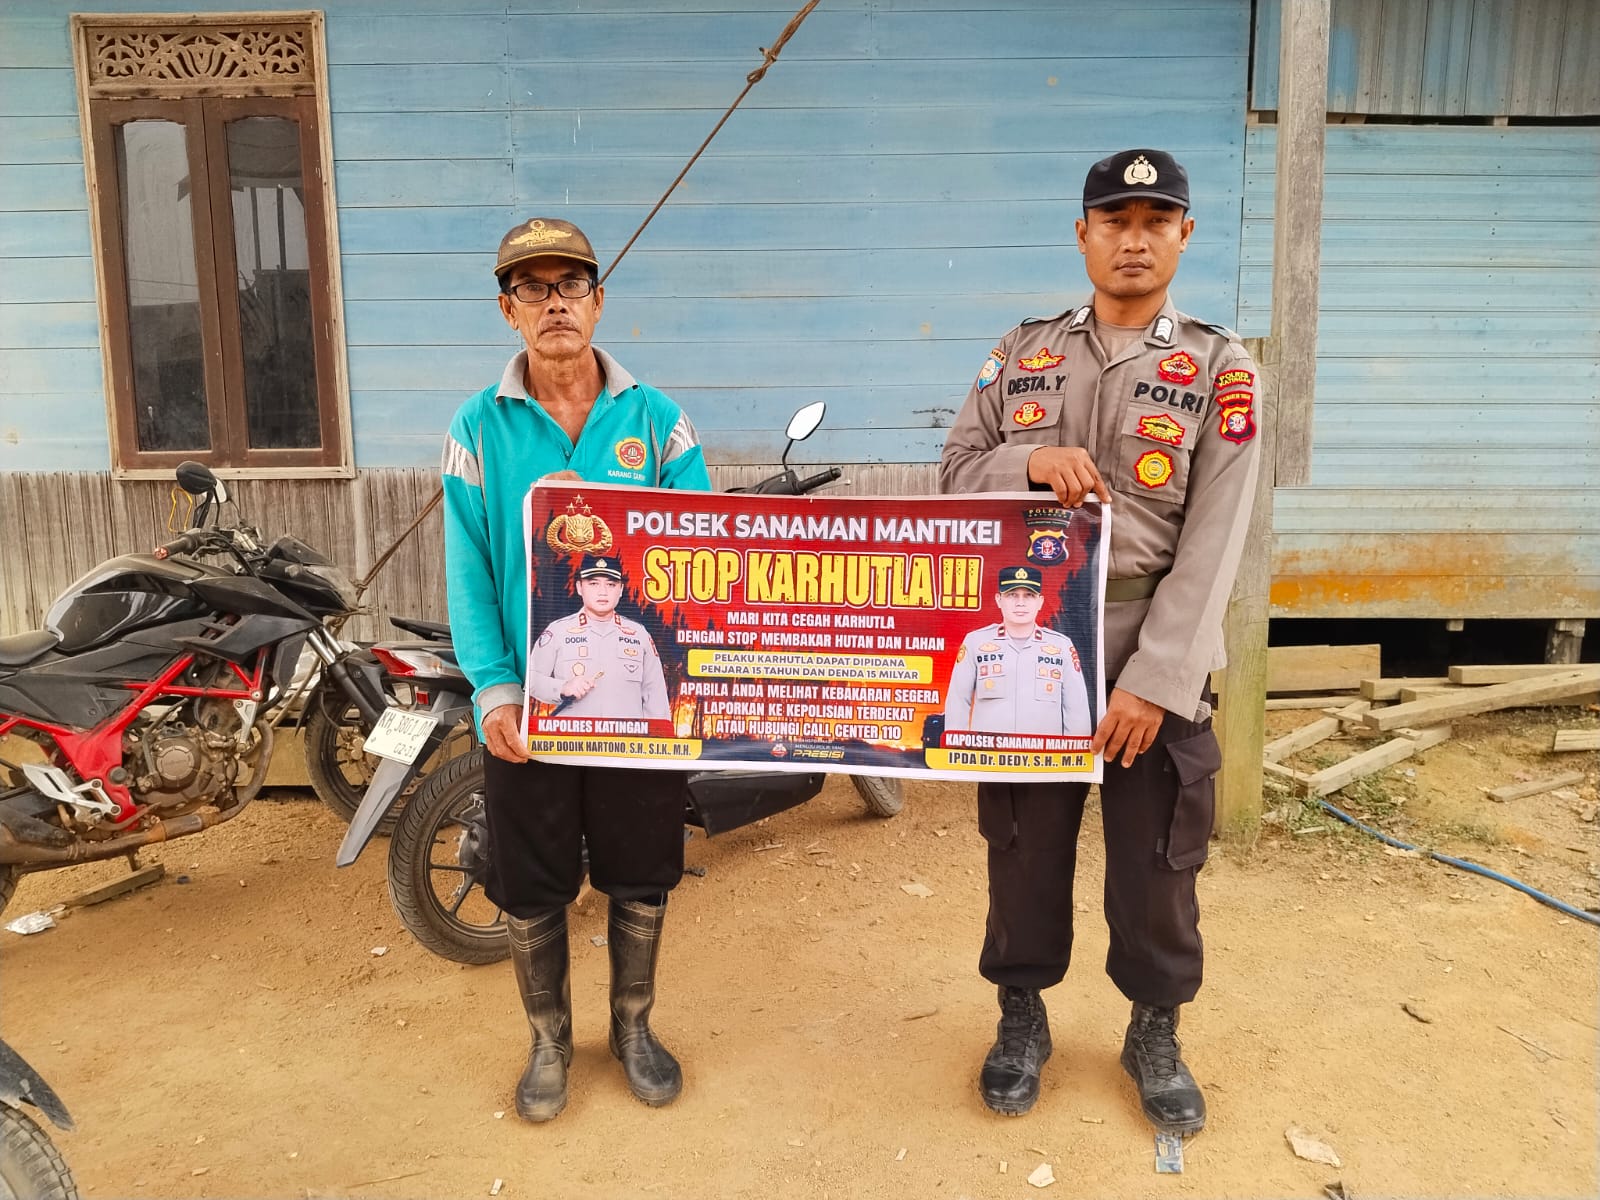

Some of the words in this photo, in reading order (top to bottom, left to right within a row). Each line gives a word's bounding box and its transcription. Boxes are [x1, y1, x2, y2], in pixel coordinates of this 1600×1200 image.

[1008, 376, 1051, 395] DESTA.
[1056, 375, 1066, 390] Y
[1134, 382, 1204, 414] POLRI
[608, 470, 632, 478] KARANG
[627, 512, 729, 537] POLSEK
[735, 514, 867, 540] SANAMAN
[874, 518, 1002, 544] MANTIKEI
[644, 547, 742, 603] STOP
[746, 551, 936, 609] KARHUTLA
[940, 556, 983, 610] !!!
[727, 612, 759, 624] MARI
[762, 613, 788, 626] KITA
[792, 614, 830, 627] CEGAH
[834, 615, 895, 629] KARHUTLA
[565, 636, 588, 644] DODIK
[678, 630, 724, 644] DENGAN
[728, 632, 758, 644] STOP
[761, 632, 832, 647] MEMBAKAR
[835, 635, 874, 648] HUTAN
[877, 636, 902, 649] DAN
[905, 637, 945, 650] LAHAN
[714, 653, 754, 662] PELAKU
[758, 655, 814, 664] KARHUTLA
[816, 657, 852, 666] DAPAT
[853, 658, 905, 667] DIPIDANA
[976, 654, 1004, 663] DEDY
[1038, 656, 1063, 666] POLRI
[700, 664, 750, 674] PENJARA
[752, 666, 762, 674] 15
[764, 667, 800, 676] TAHUN
[802, 668, 826, 676] DAN
[828, 669, 864, 678] DENDA
[867, 670, 876, 678] 15
[880, 671, 918, 680] MILYAR
[680, 682, 728, 696] APABILA
[732, 684, 764, 698] ANDA
[768, 686, 818, 699] MELIHAT
[822, 687, 891, 702] KEBAKARAN
[894, 689, 940, 704] SEGERA
[704, 701, 764, 716] LAPORKAN
[768, 703, 782, 716] KE
[786, 704, 852, 719] KEPOLISIAN
[856, 706, 914, 722] TERDEKAT
[378, 711, 396, 729] KH
[538, 720, 592, 733] KAPOLRES
[594, 721, 648, 734] KATINGAN
[716, 720, 745, 734] ATAU
[749, 721, 800, 735] HUBUNGI
[803, 723, 832, 737] CALL
[834, 724, 878, 739] CENTER
[882, 726, 902, 740] 110
[531, 740, 554, 752] AKBP
[556, 741, 584, 752] DODIK
[586, 742, 628, 754] HARTONO,
[673, 744, 692, 756] M.H.
[946, 734, 994, 748] KAPOLSEK
[996, 736, 1044, 750] SANAMAN
[792, 750, 845, 759] PRESISI
[949, 752, 976, 764] IPDA
[980, 754, 996, 766] Dr.
[998, 754, 1031, 768] DEDY,
[1062, 756, 1086, 766] M.H.
